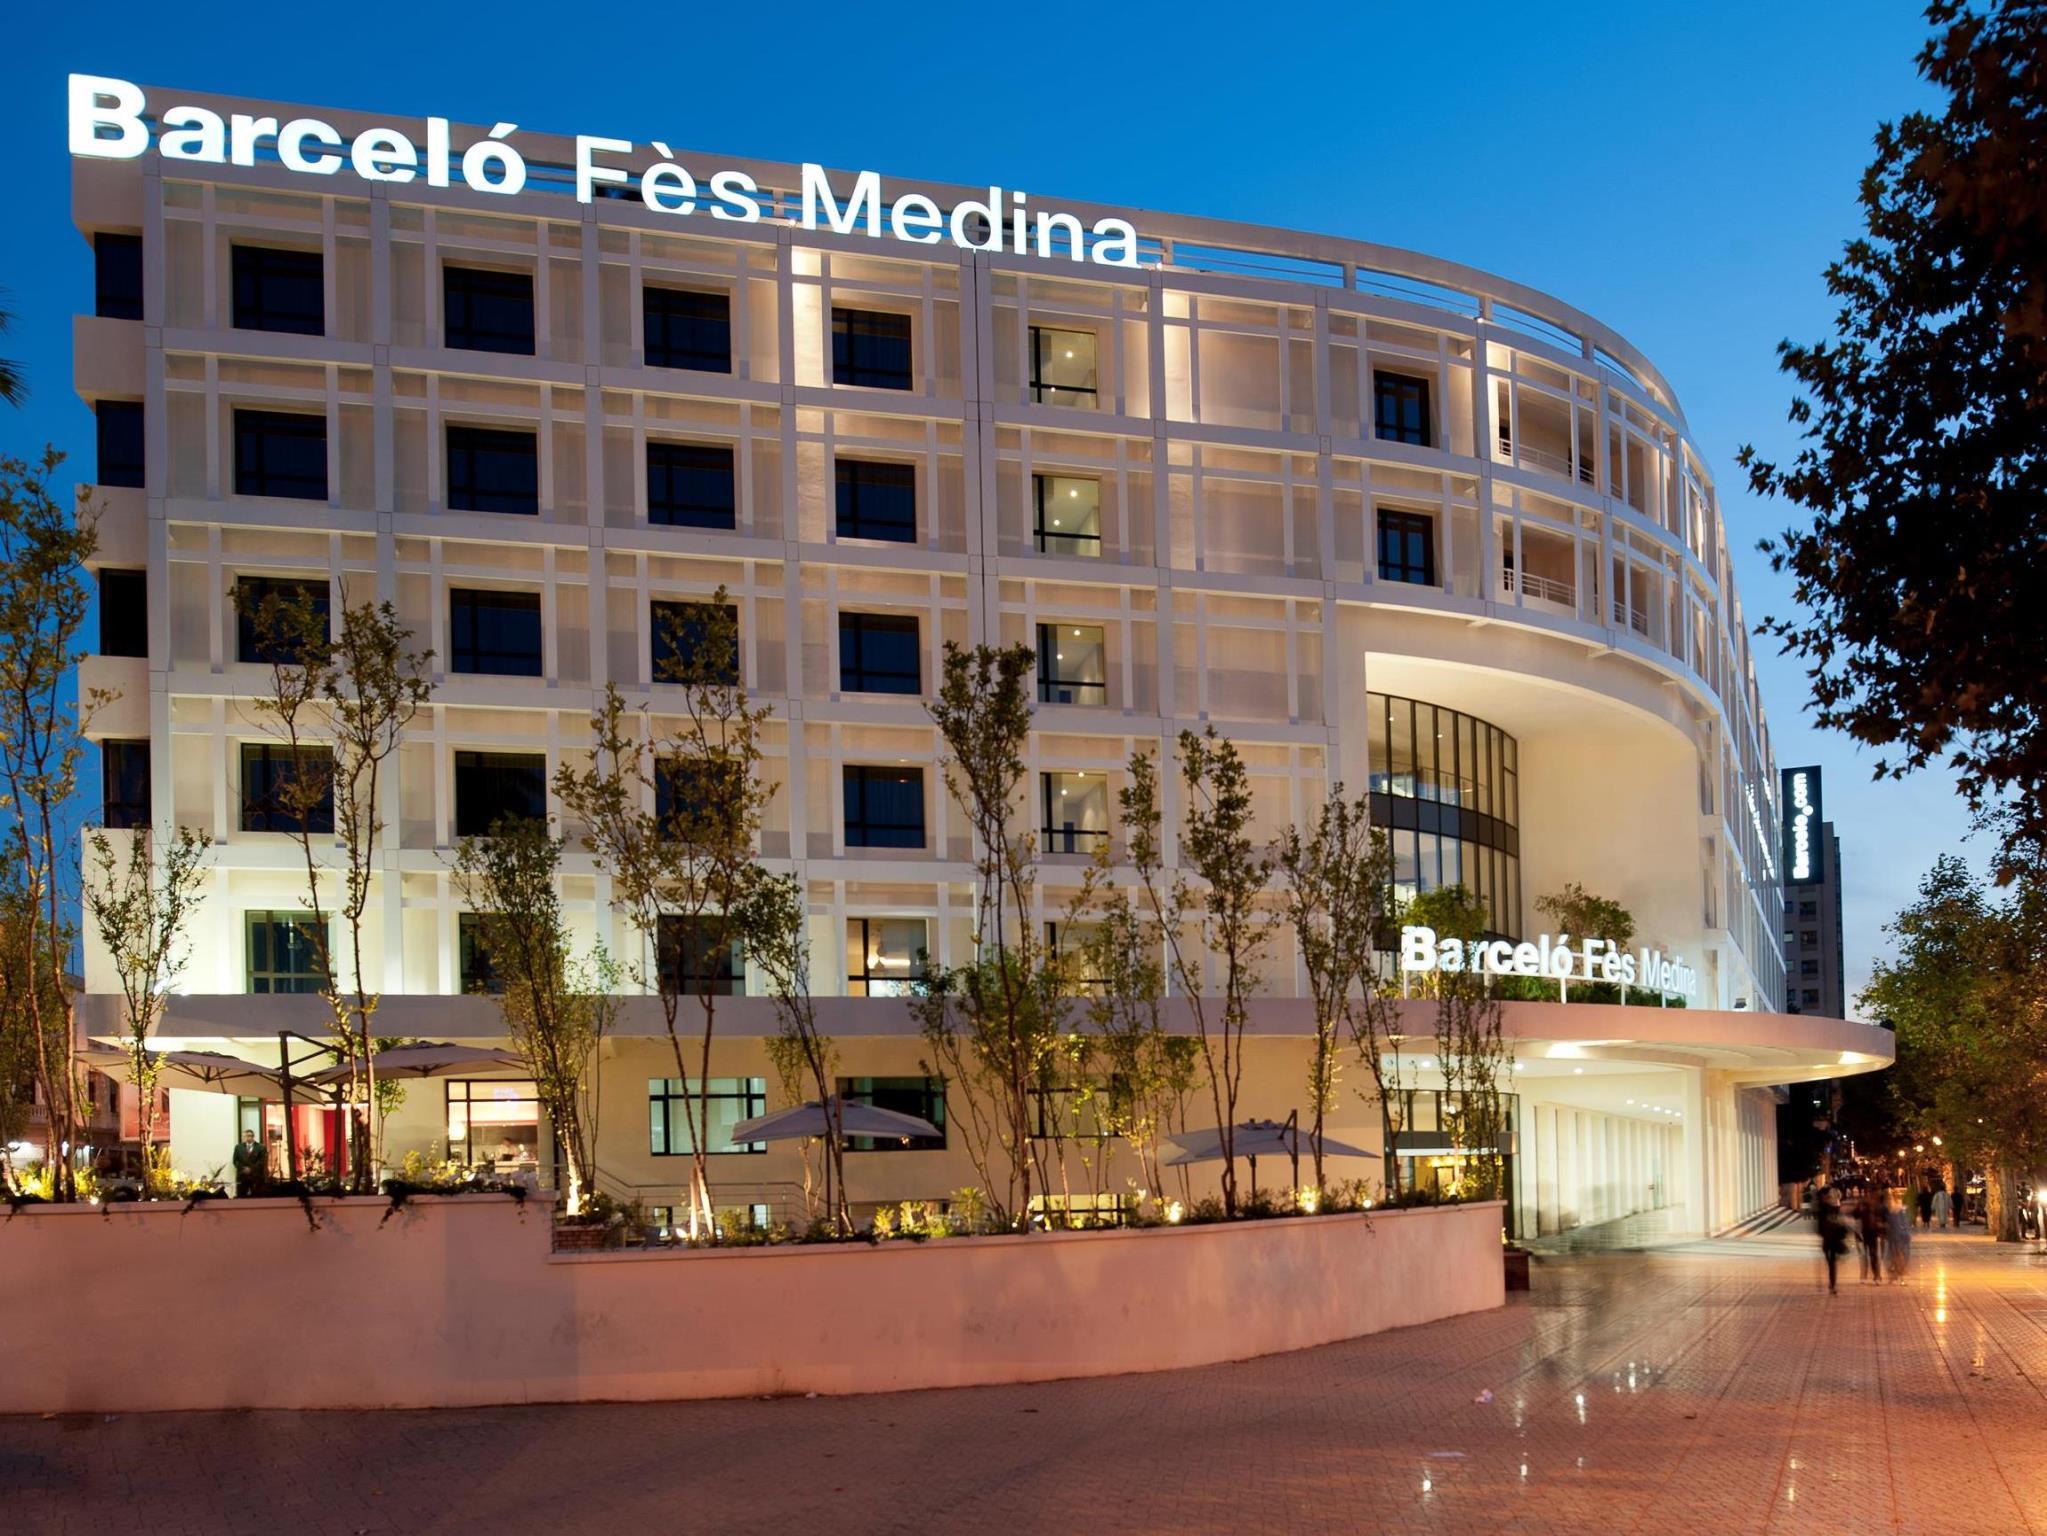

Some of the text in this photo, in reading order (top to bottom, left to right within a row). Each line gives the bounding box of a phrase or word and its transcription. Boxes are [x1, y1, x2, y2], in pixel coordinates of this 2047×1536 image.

[68, 74, 1143, 269] Barceló Fès Medina
[1401, 925, 1697, 997] Barceló Fès Medina
